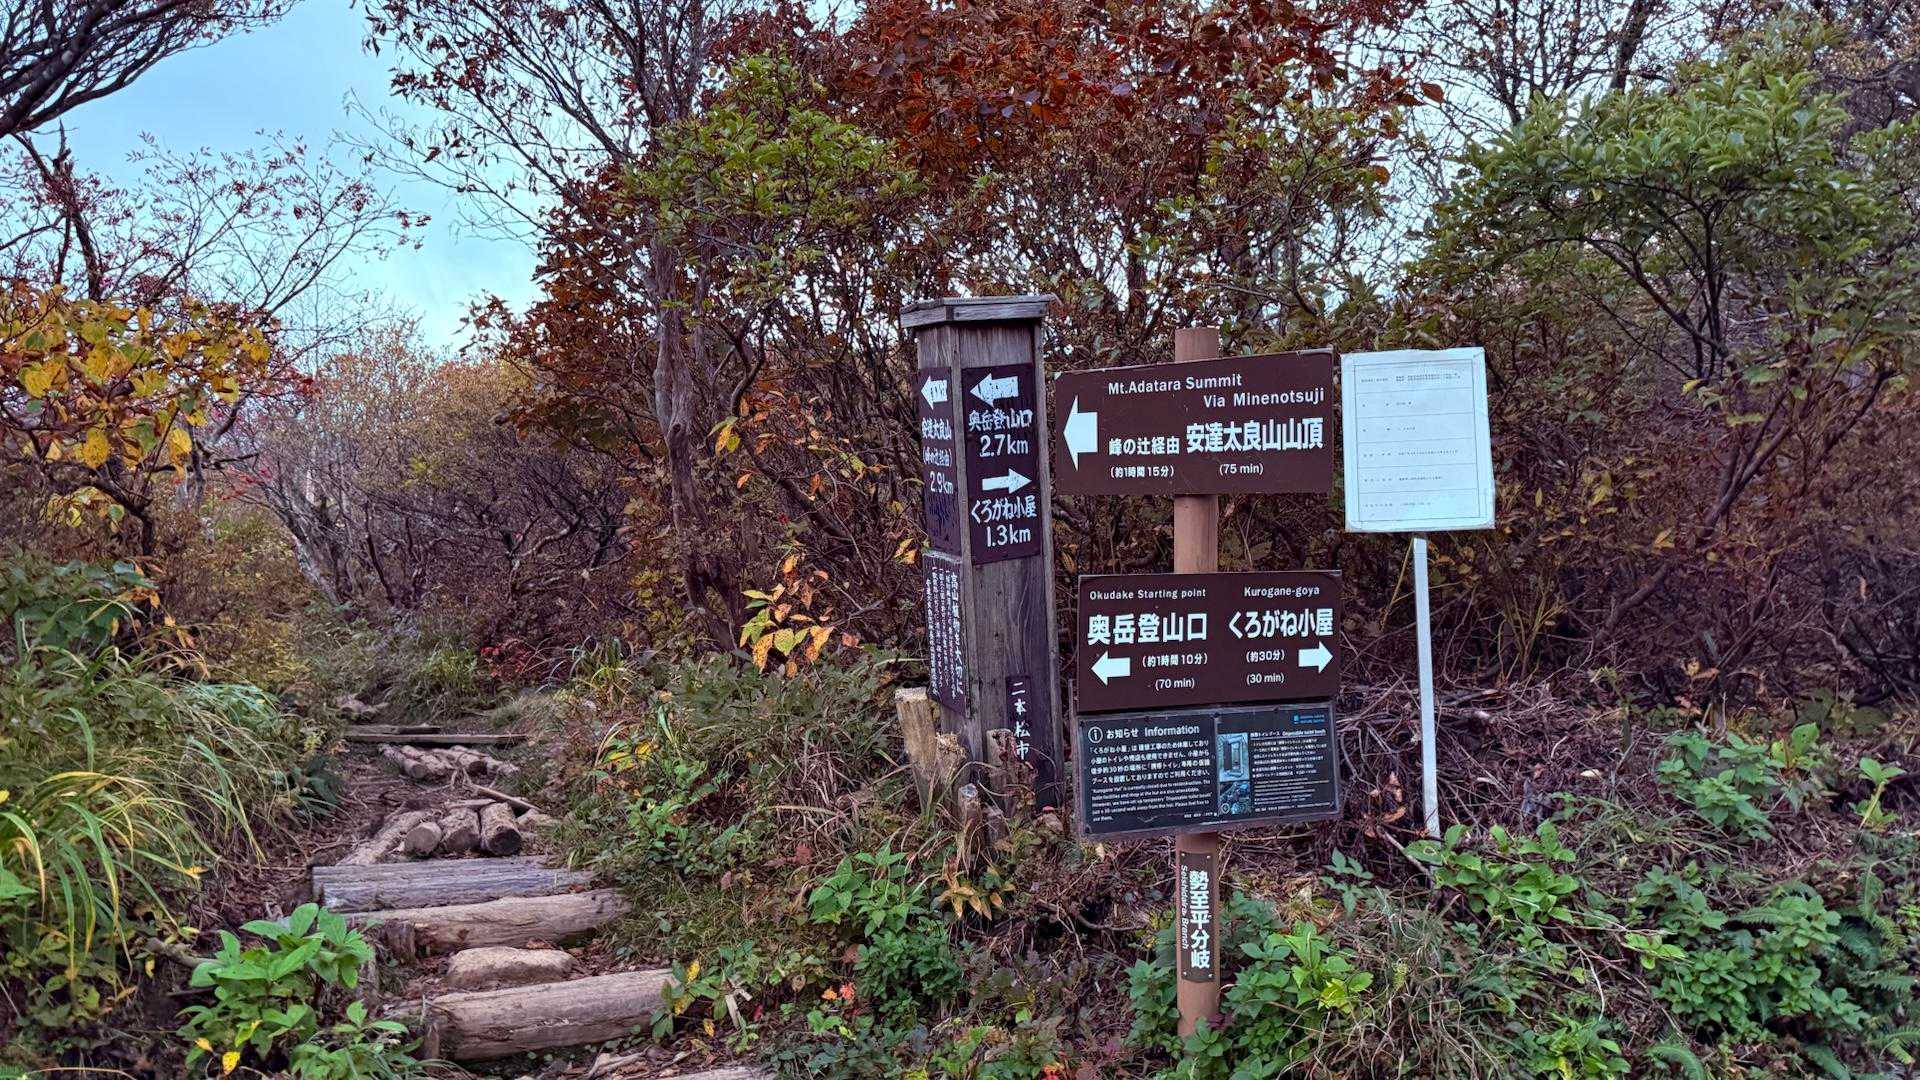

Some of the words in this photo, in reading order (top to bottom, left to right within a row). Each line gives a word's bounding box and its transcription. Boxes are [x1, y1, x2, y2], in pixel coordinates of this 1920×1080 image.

[1108, 378, 1181, 395] Mt.Adatara
[1186, 373, 1242, 390] Summit
[1204, 395, 1226, 408] Via
[1233, 388, 1325, 407] Minenotsuji
[968, 408, 1033, 432] 奥岳登山口
[979, 434, 1029, 458] 2.7km
[1108, 436, 1180, 456] 峰の辻経由
[1186, 417, 1324, 454] 安達太良山山頂
[1219, 463, 1237, 476] (75
[1240, 462, 1264, 474] min)
[971, 495, 1038, 524] くろがね小屋
[986, 523, 1031, 548] 1.3km
[1089, 590, 1134, 600] Okudake
[1137, 589, 1178, 601] Starting
[1181, 589, 1206, 600] point
[1244, 586, 1320, 599] Kurogane-goya
[1087, 612, 1208, 646] 奥岳登山口
[1228, 608, 1334, 639] くろがね小屋
[1155, 678, 1172, 691] (70
[1174, 678, 1195, 689] min)
[1246, 673, 1263, 685] (30
[1264, 672, 1285, 684] min)
[1011, 681, 1032, 760] 二本松市
[1106, 727, 1139, 740] お知らせ
[1144, 725, 1200, 738] Information
[1189, 870, 1210, 970] 勢至平分岐
